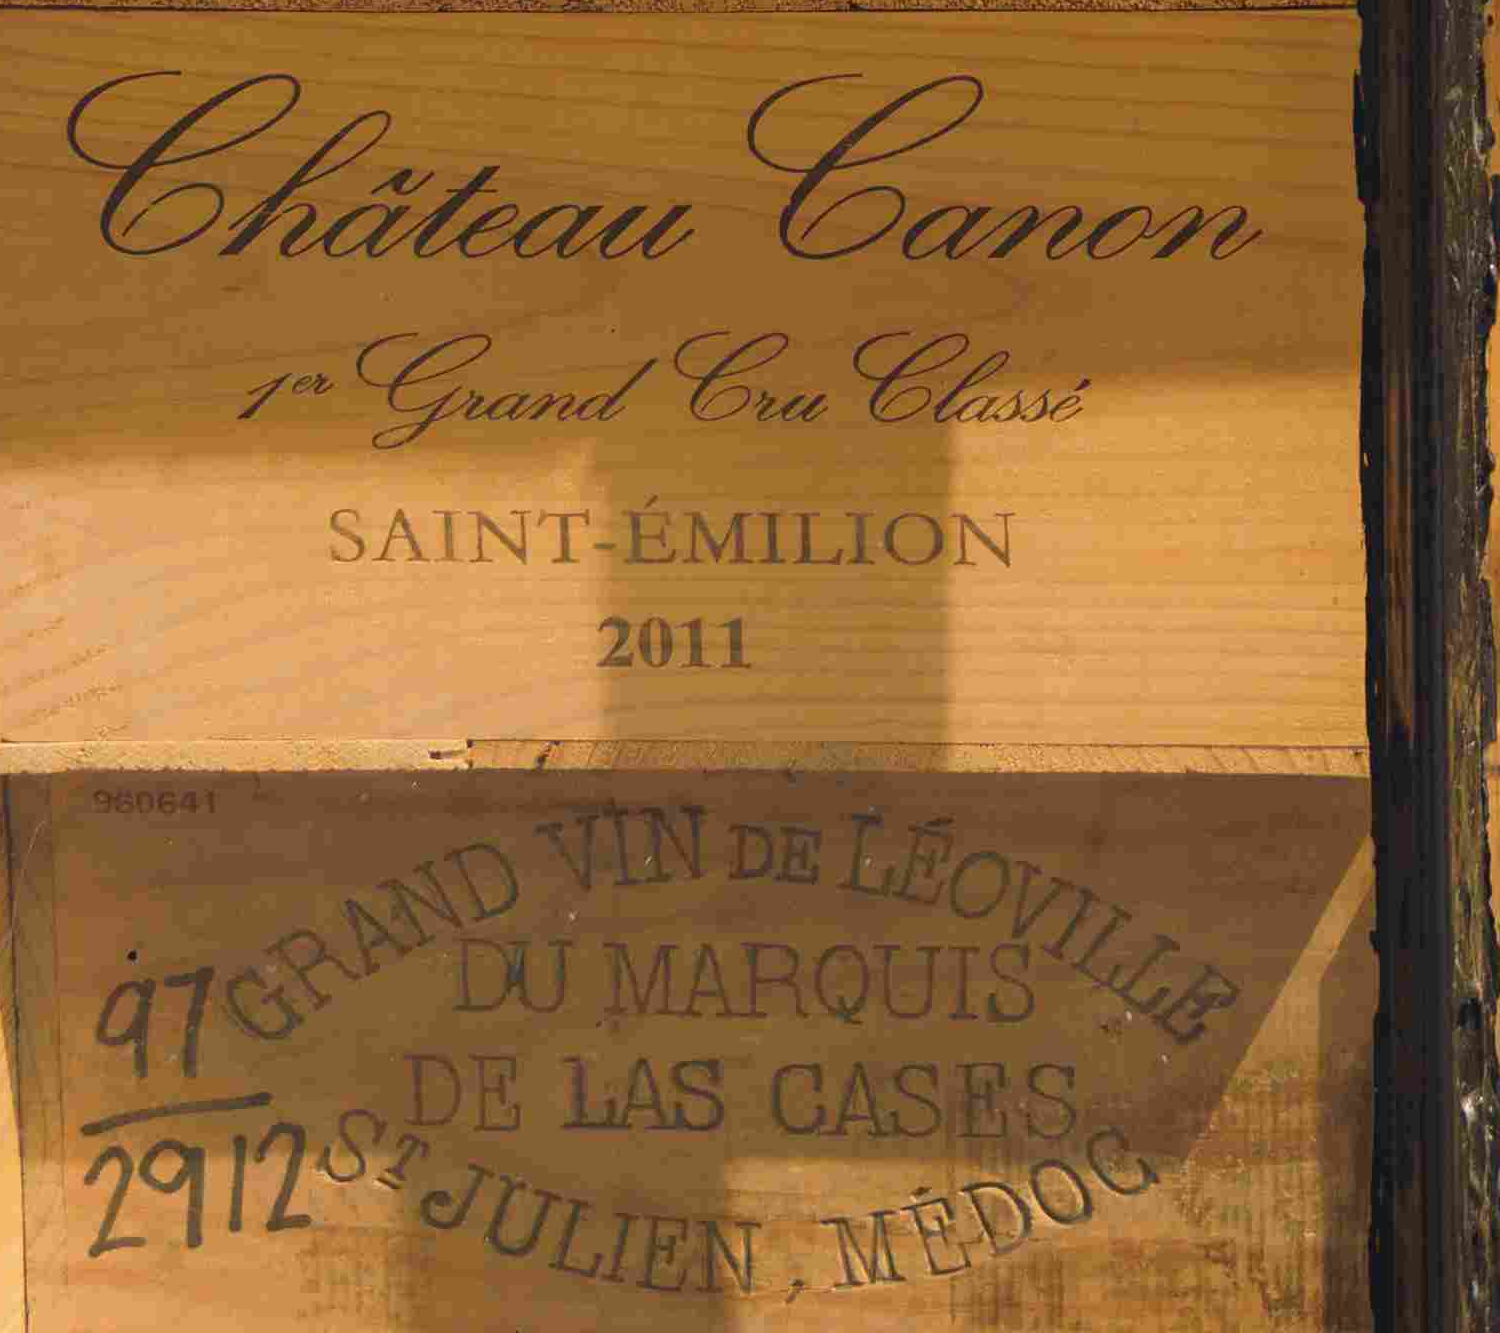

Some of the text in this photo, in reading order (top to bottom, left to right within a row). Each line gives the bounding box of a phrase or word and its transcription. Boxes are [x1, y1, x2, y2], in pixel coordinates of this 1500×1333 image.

[66, 70, 1262, 263] Château Canon
[236, 329, 1088, 451] 1er Grand Cru Classé
[328, 497, 1017, 571] SAINT-ÉMILION
[595, 613, 753, 670] 2011
[222, 805, 1243, 1052] GRAND VIN DE LÉOVILLE
[453, 936, 1038, 1027] DU MARQUIS
[403, 1052, 1079, 1139] DE LAS CASES
[820, 1123, 1159, 1294] MÉDOC
